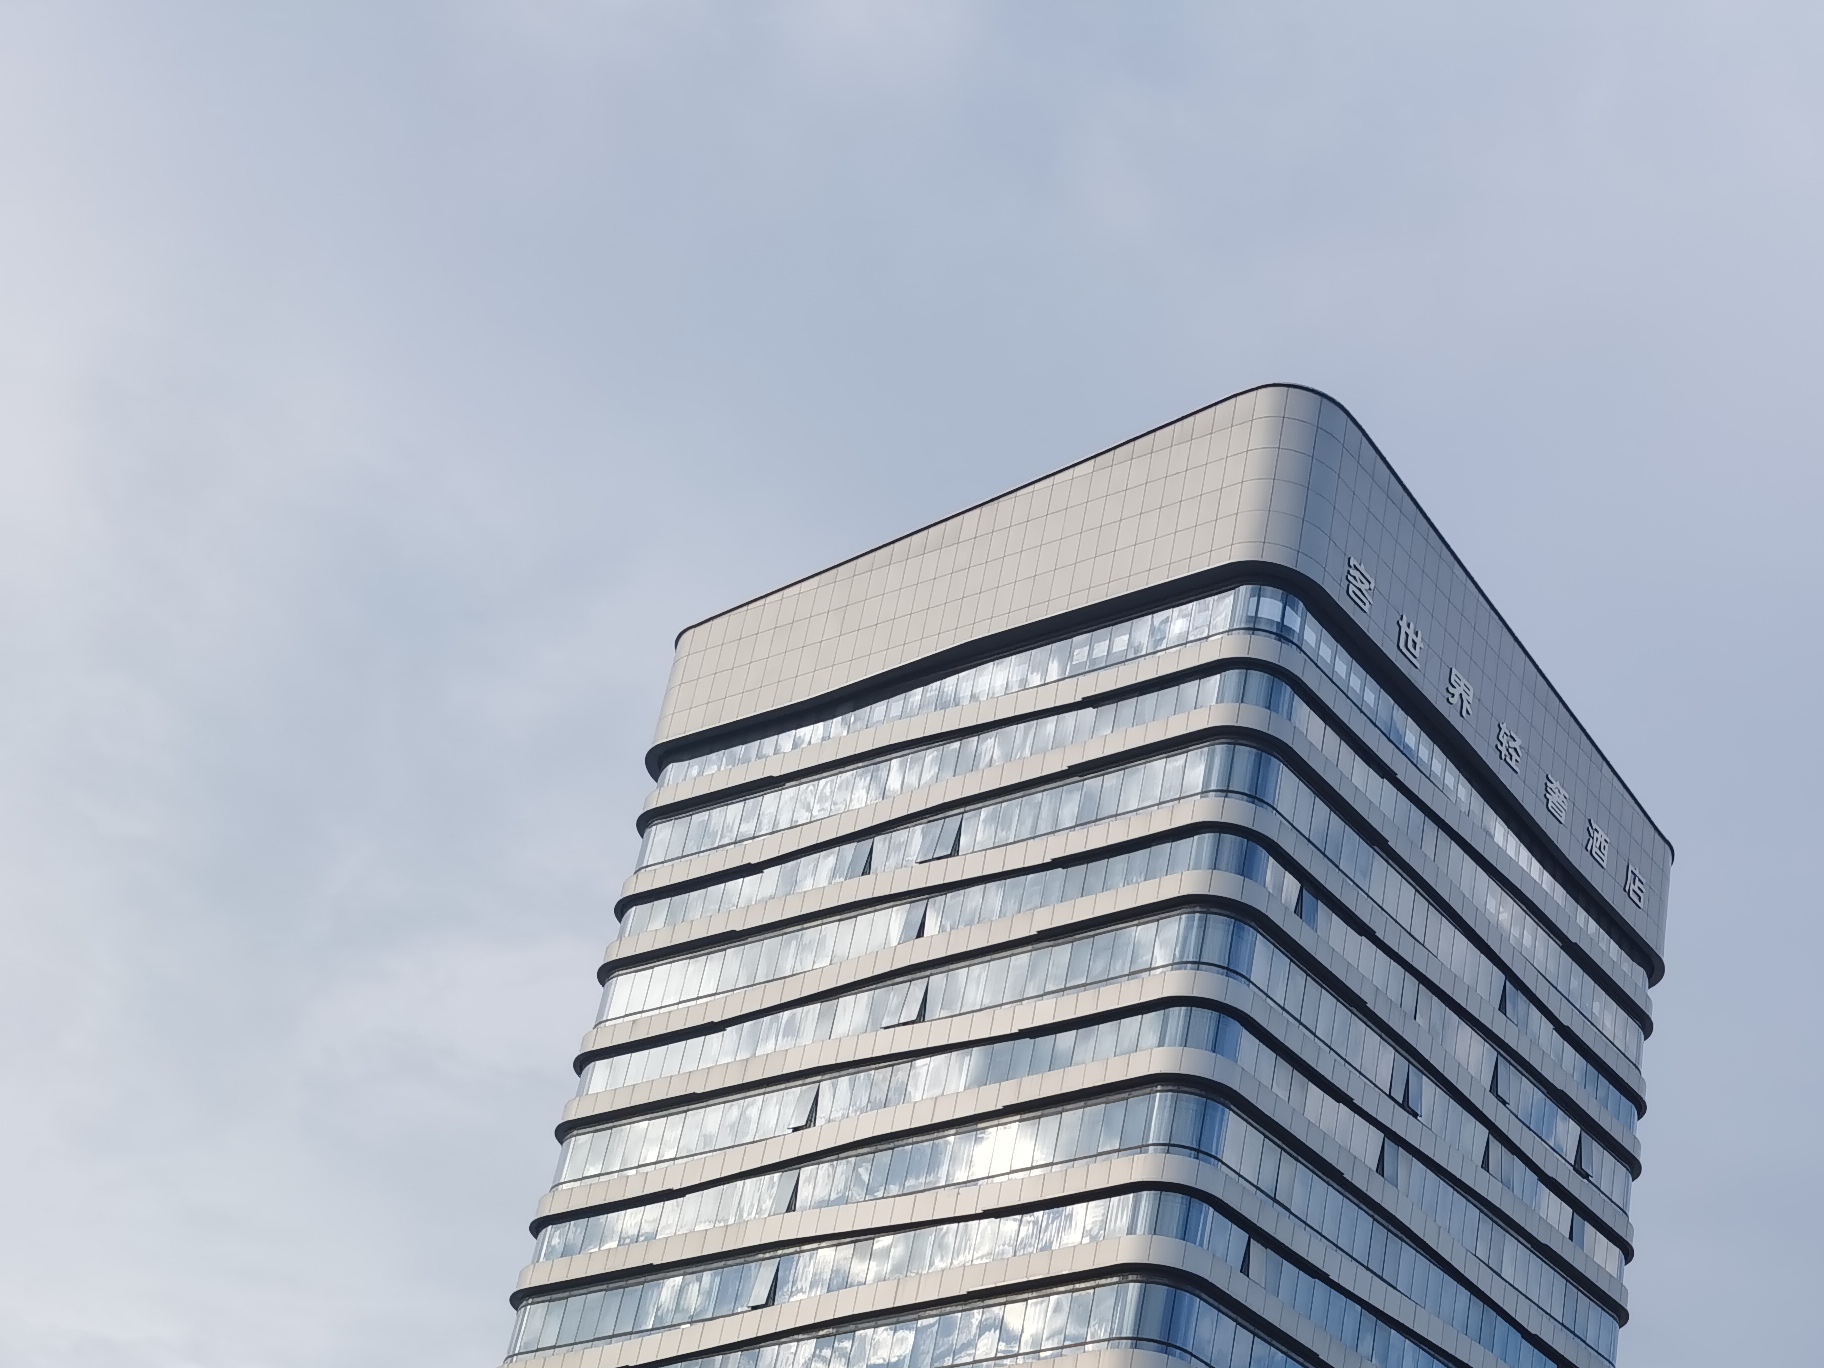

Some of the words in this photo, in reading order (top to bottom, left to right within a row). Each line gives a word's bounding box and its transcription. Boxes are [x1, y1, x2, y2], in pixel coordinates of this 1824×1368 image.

[1347, 555, 1646, 911] 客世界轻奢酒店
